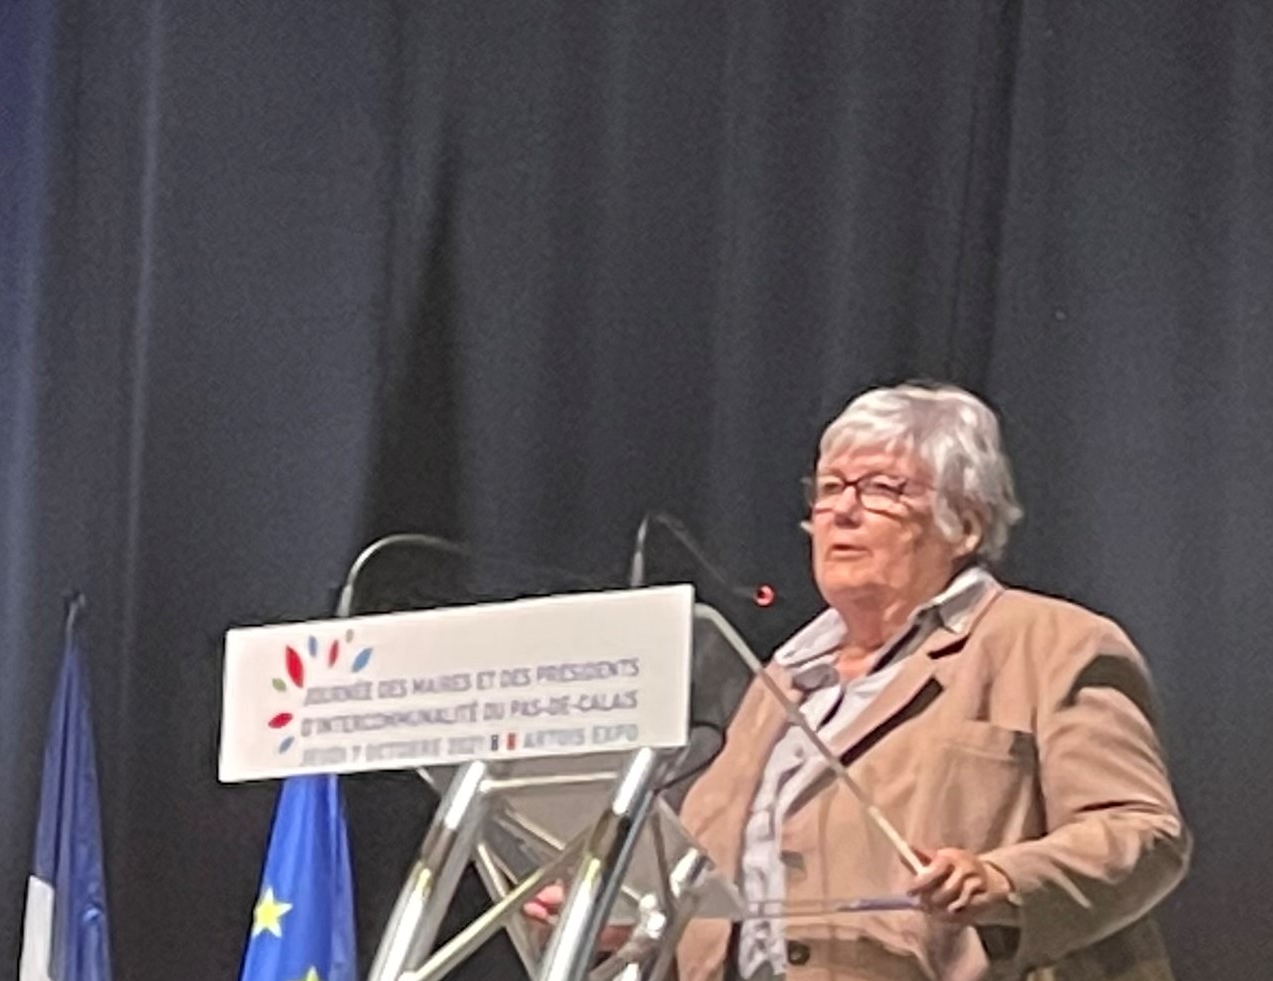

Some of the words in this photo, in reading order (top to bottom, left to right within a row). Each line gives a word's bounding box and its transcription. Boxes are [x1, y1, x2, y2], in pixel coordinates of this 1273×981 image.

[378, 679, 407, 699] DES
[476, 671, 497, 690] ET
[500, 668, 532, 687] DES
[483, 701, 505, 720] DU
[511, 689, 639, 717] PAS-DE-CALAIS
